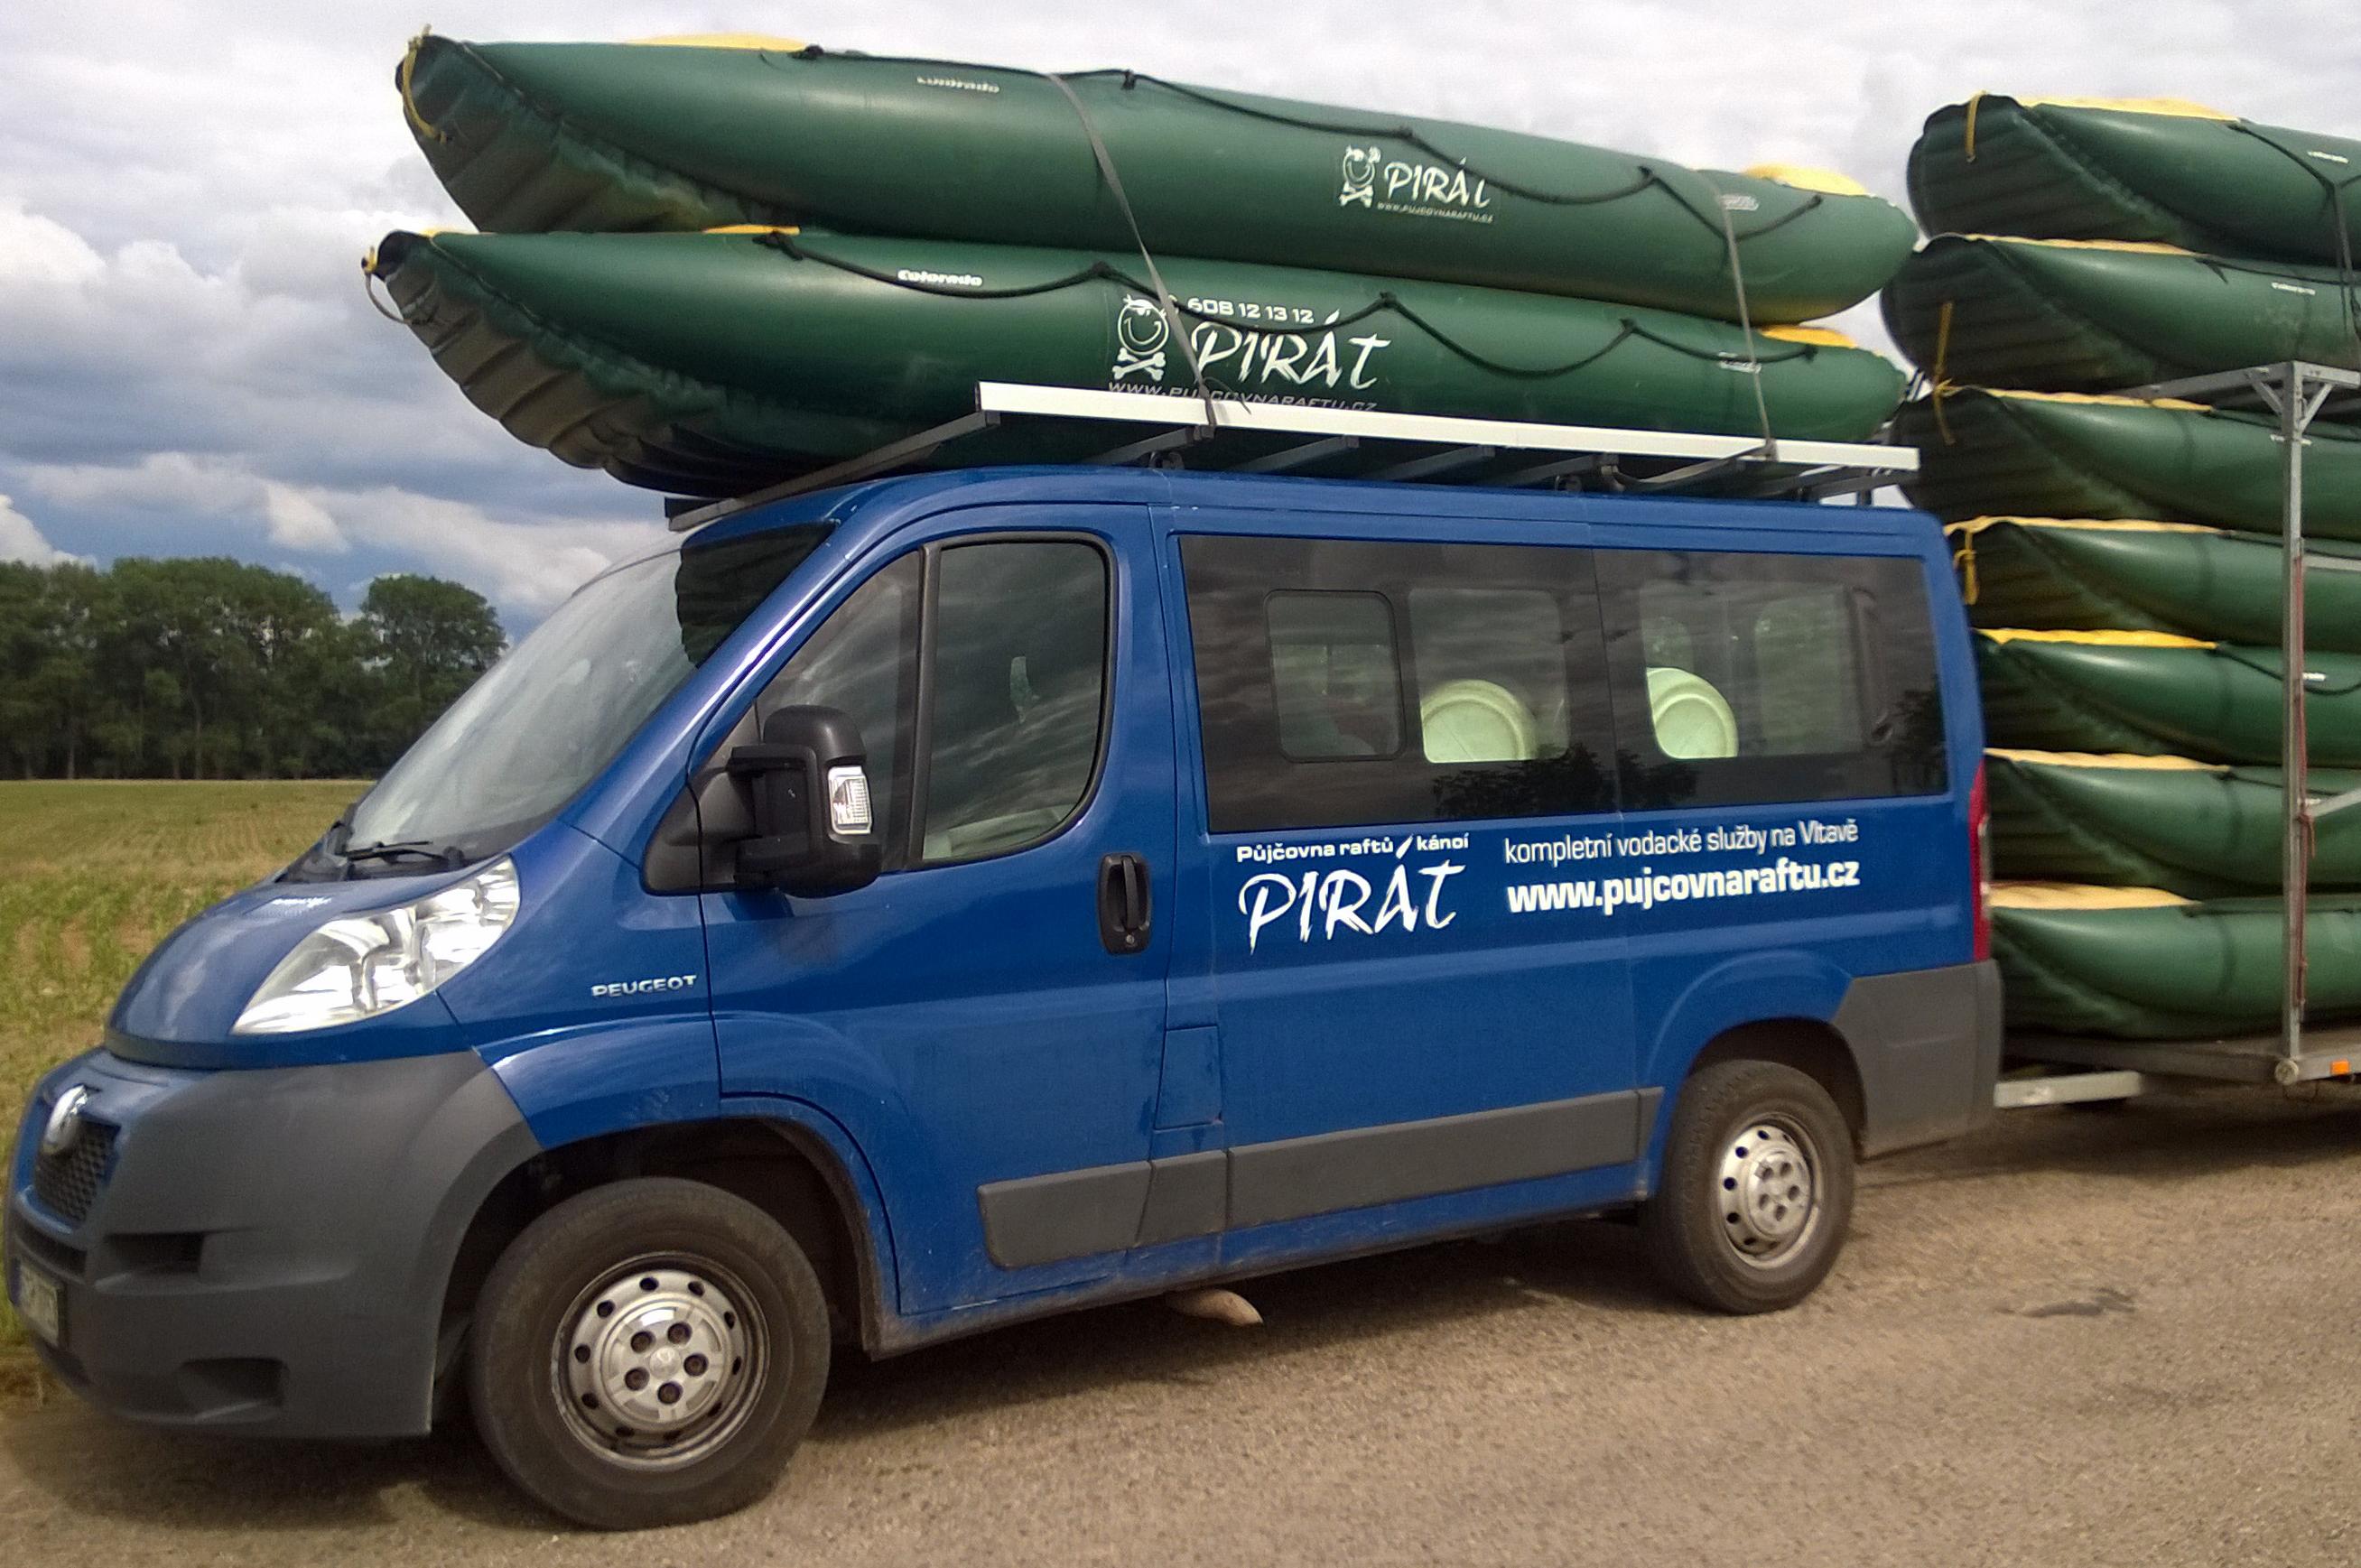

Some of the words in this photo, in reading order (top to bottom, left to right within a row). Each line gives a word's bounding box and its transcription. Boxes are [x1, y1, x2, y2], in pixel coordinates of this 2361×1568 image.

[1187, 298, 1234, 316] 608
[1238, 302, 1261, 319] 12
[1265, 306, 1287, 321] 13
[1292, 309, 1315, 324] 12
[1191, 309, 1391, 389] PIRÁT
[1236, 842, 1335, 864] Půjčovna
[1340, 837, 1394, 856] raftů
[1417, 832, 1469, 851] kánoí
[1504, 831, 1613, 868] kompletní
[1617, 828, 1702, 858] vodacké
[1706, 824, 1768, 856] služby
[1771, 827, 1797, 847] na
[1238, 834, 1466, 955] PIRÁT
[1507, 857, 1861, 915] www.pujcovnaraftu.cz
[591, 975, 696, 997] PEUGEOT
